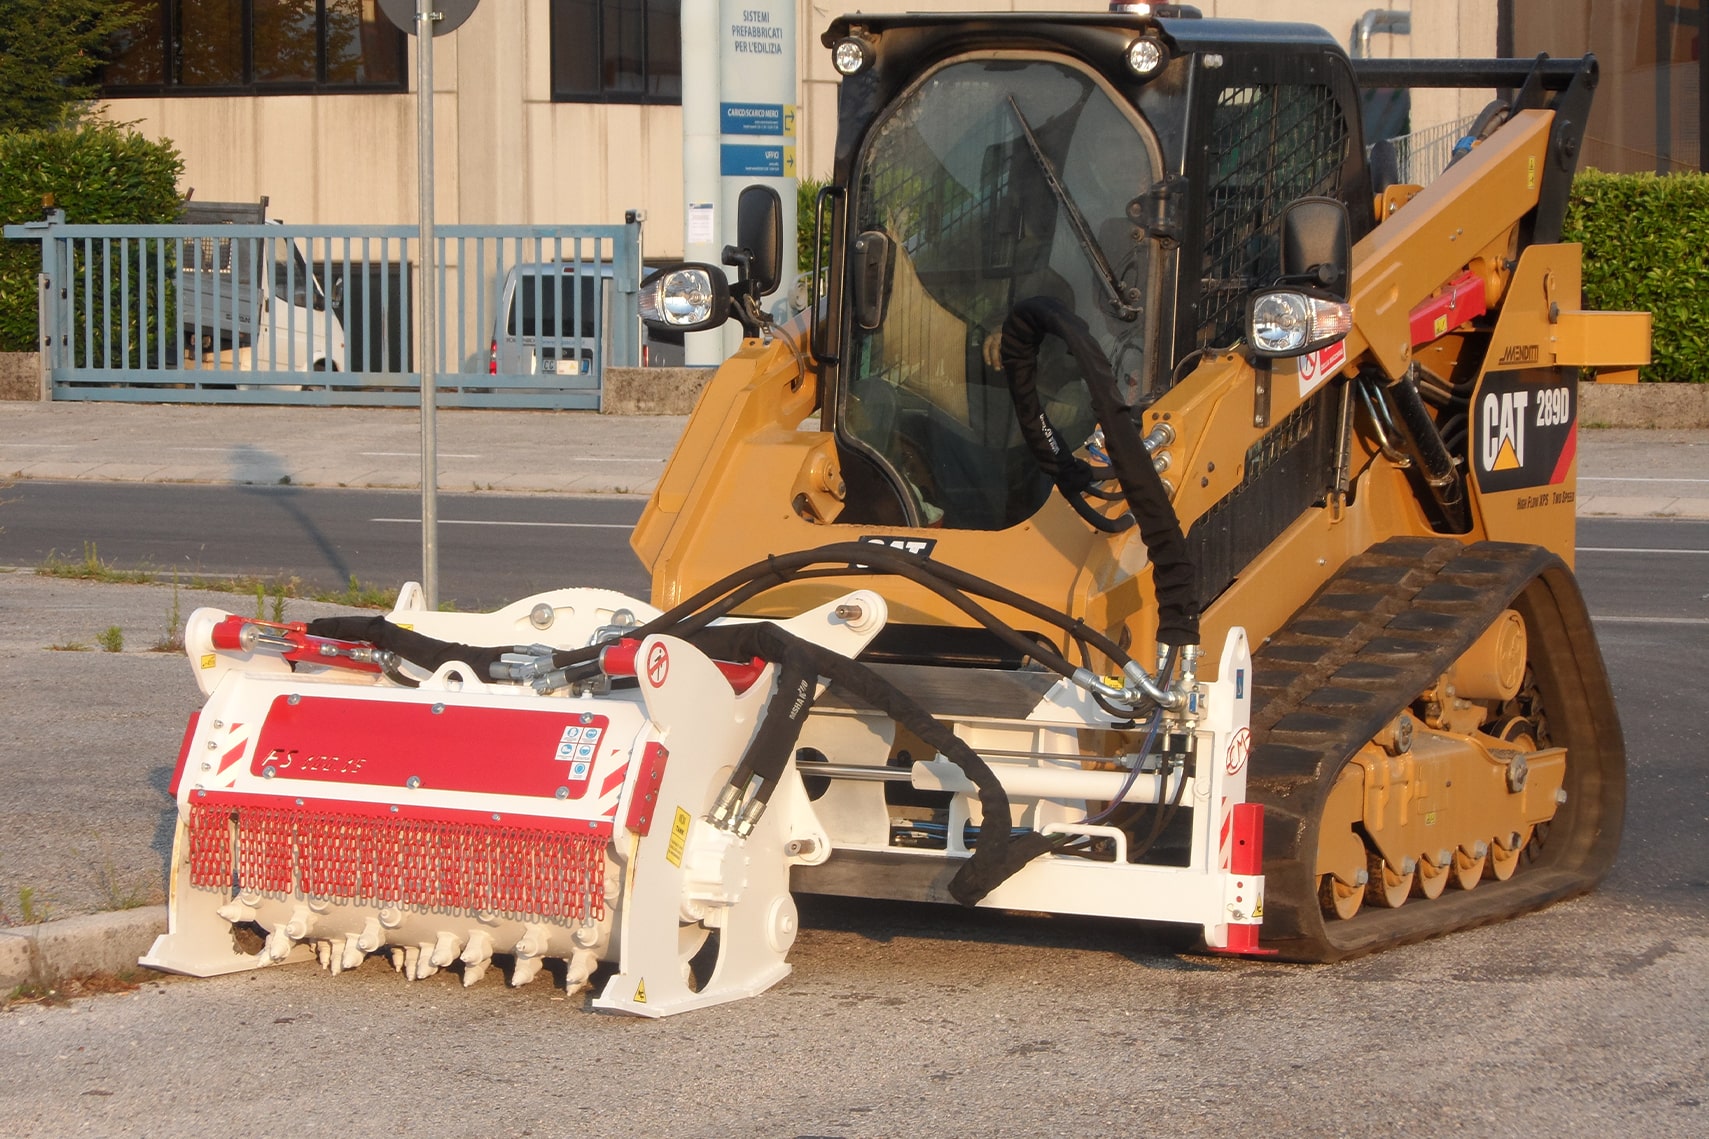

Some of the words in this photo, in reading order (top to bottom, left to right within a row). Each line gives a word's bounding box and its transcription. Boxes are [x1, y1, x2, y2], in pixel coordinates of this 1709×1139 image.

[743, 10, 769, 23] SISTEMI
[732, 25, 783, 39] PREFABBRICATI
[735, 41, 747, 53] PER
[749, 41, 783, 55] L'EDILIZIA
[1536, 387, 1570, 427] 289D
[1483, 391, 1528, 472] CAT
